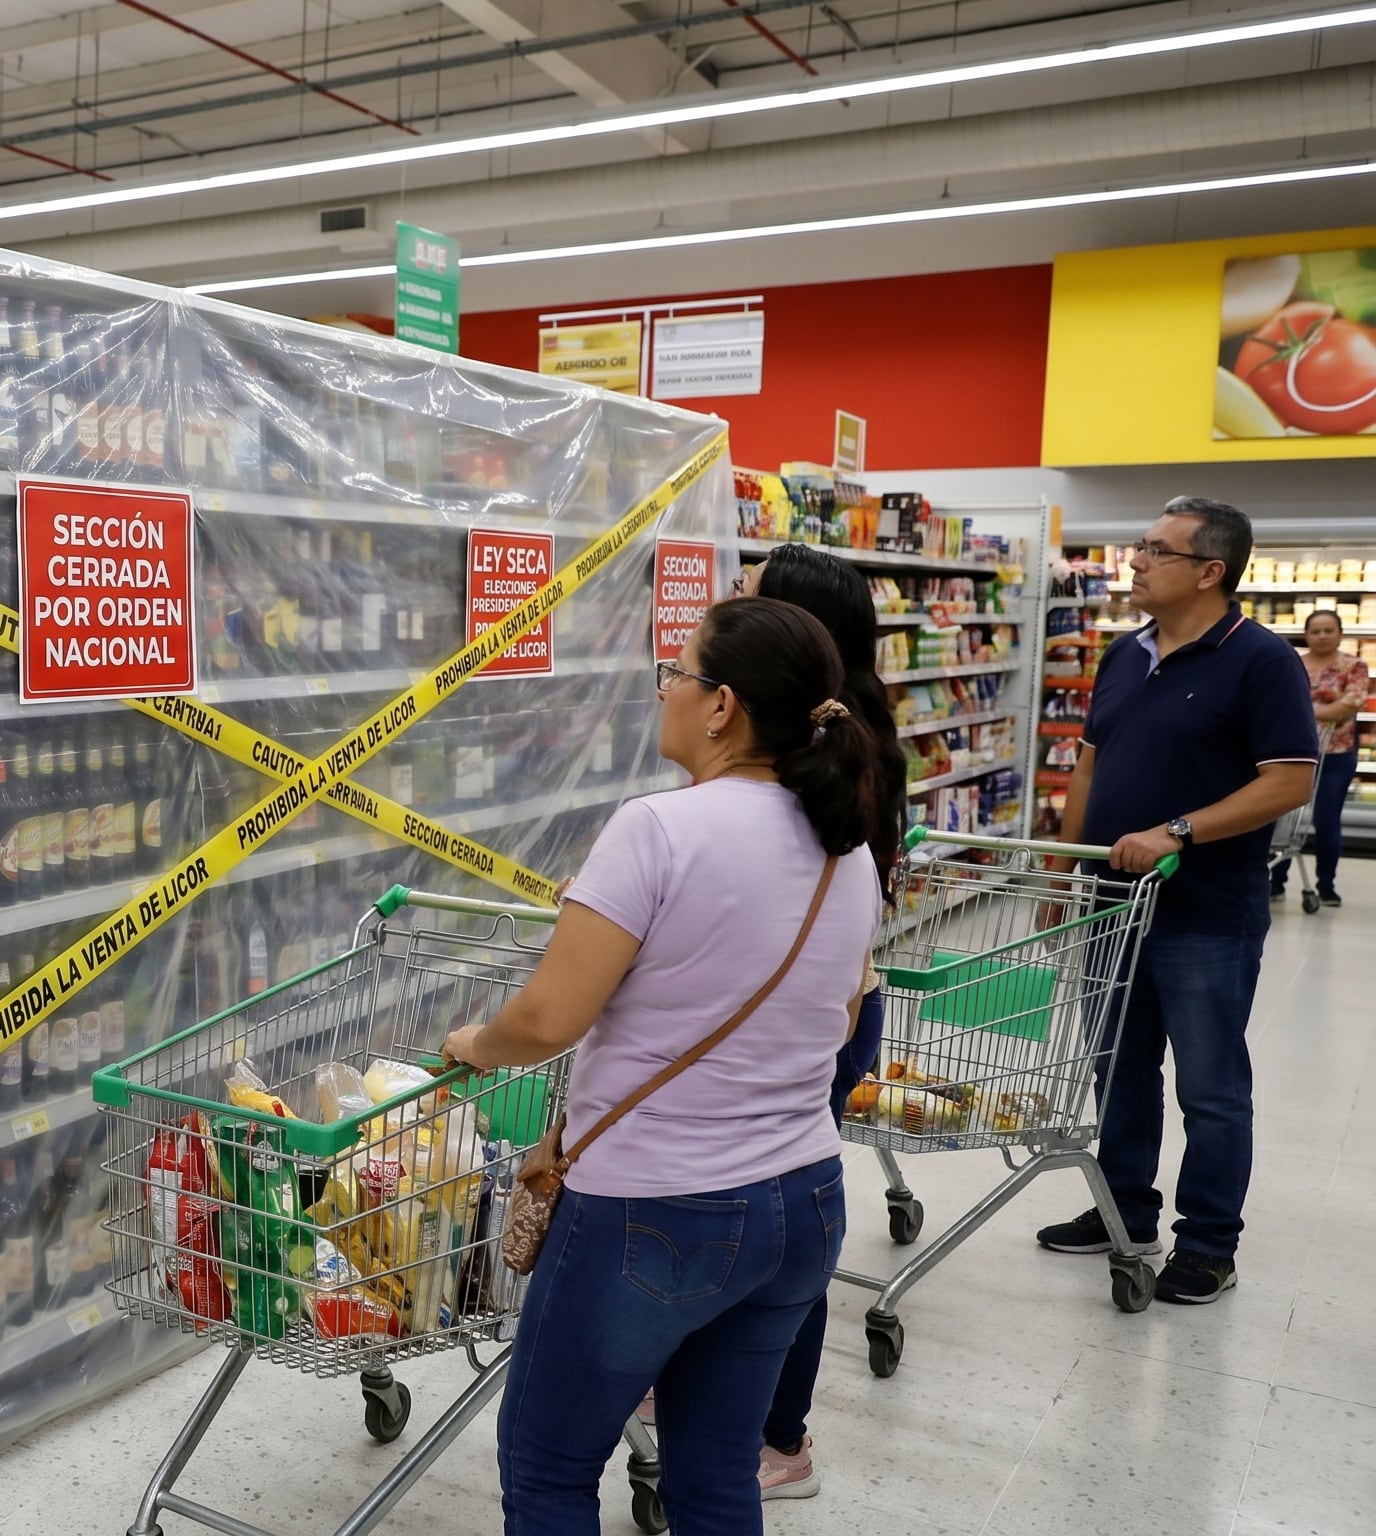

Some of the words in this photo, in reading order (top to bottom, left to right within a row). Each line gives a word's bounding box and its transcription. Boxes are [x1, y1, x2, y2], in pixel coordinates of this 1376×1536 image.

[53, 512, 164, 550] SECCIÓN
[47, 555, 171, 589] CERRADA
[473, 545, 504, 574] LEY
[506, 547, 547, 575] SECA
[662, 553, 707, 578] SECCIÓN
[484, 579, 537, 595] ELECCIONES
[661, 581, 708, 601] CERRADA
[34, 596, 91, 627] POR
[97, 596, 183, 627] ORDEN
[657, 606, 675, 624] POR
[45, 636, 176, 668] NACIONAL
[435, 642, 487, 695] PROHIBIDA
[487, 631, 500, 656] LA
[499, 612, 528, 643] VENTA
[527, 598, 541, 621] DE
[539, 580, 564, 612] LICOR
[518, 641, 548, 658] LICOR
[236, 782, 309, 850] PROHIBIDA
[308, 765, 328, 794] LA
[325, 735, 367, 777] VENTA
[366, 725, 383, 748] DE
[383, 695, 417, 735] LICOR
[403, 813, 449, 853] SECCIÓN
[450, 838, 494, 876] CERRADA
[55, 957, 83, 994] LA
[81, 913, 139, 971] VENTA
[138, 895, 164, 928] DE
[162, 857, 210, 909] LICOR
